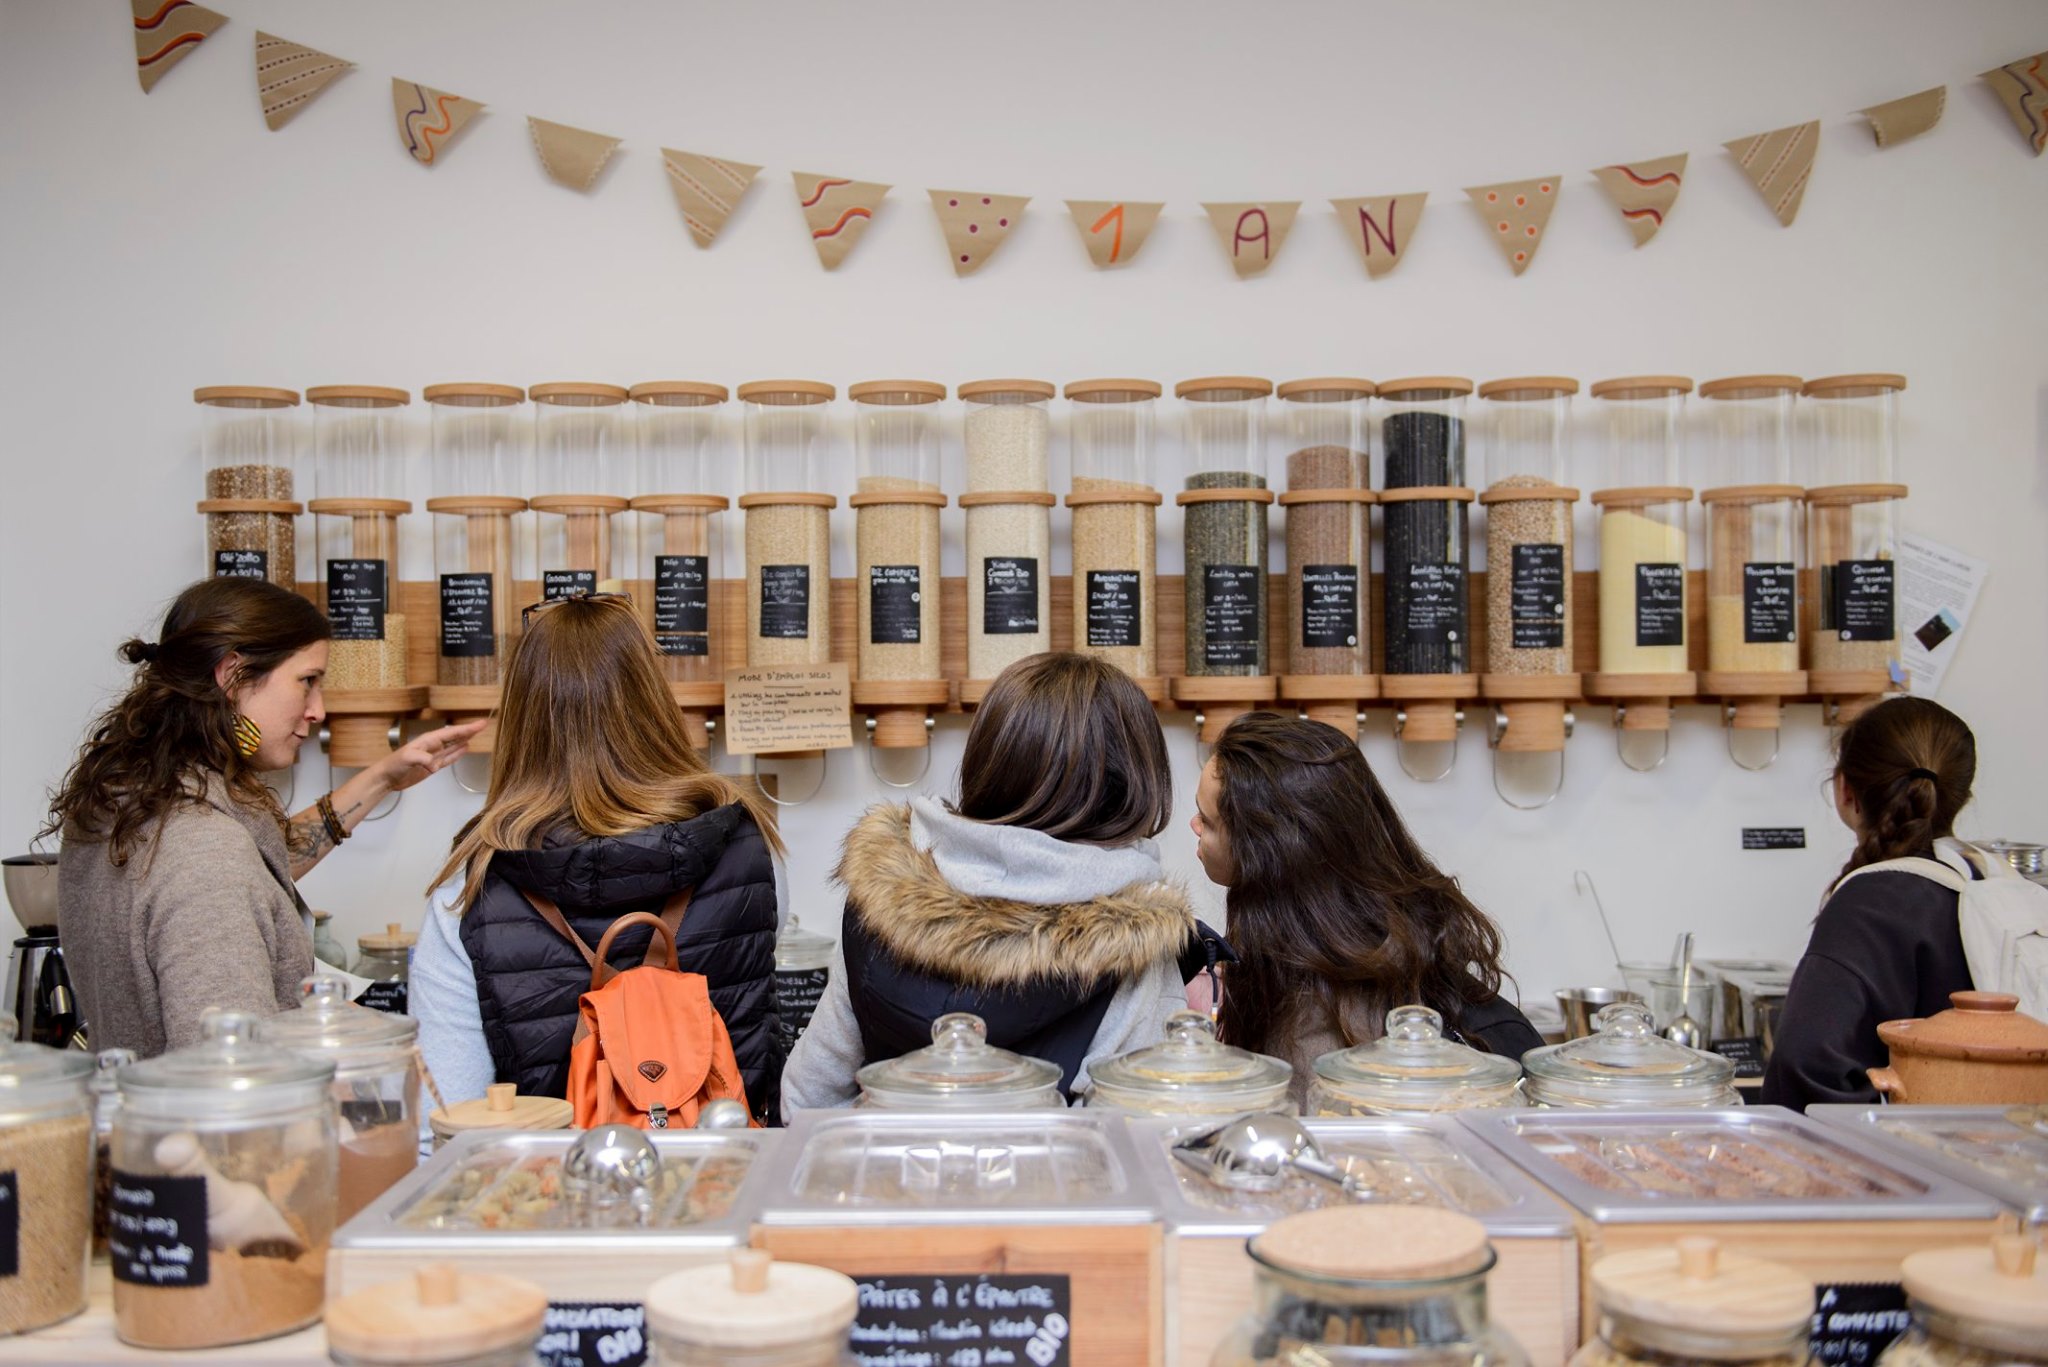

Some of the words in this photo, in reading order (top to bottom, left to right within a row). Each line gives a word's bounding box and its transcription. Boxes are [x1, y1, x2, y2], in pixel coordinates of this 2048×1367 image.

[1090, 203, 1123, 264] 1
[577, 572, 593, 581] BIO
[1851, 563, 1886, 576] QUINOA
[739, 672, 764, 682] MODE
[809, 671, 833, 681] SILOS
[931, 1279, 950, 1308] À
[596, 1326, 644, 1364] BIO
[1024, 1311, 1070, 1367] BIO
